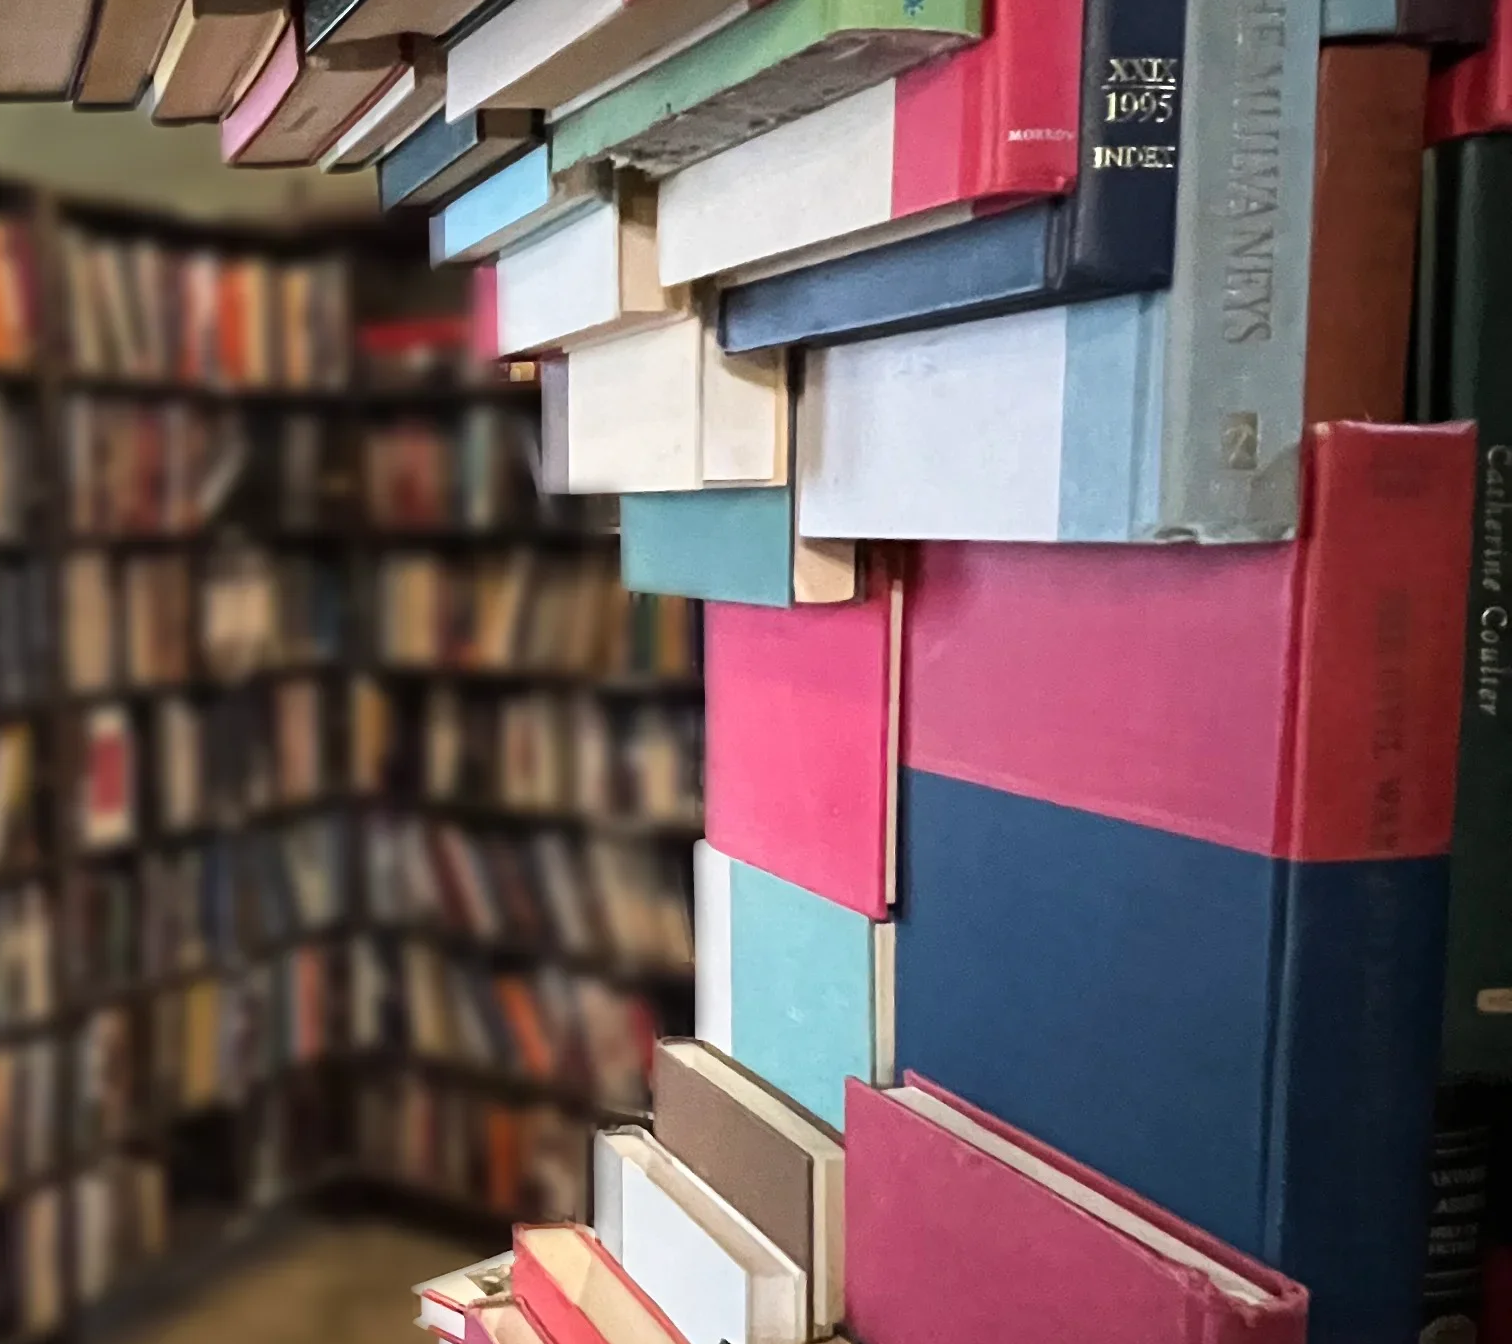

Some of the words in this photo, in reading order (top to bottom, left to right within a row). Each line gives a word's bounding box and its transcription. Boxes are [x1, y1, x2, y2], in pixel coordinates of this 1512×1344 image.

[1108, 57, 1176, 84] XXIX
[1105, 90, 1174, 122] 1995
[1093, 146, 1176, 171] INDEX
[1483, 445, 1510, 591] Catherine
[1478, 606, 1508, 715] Coulter
